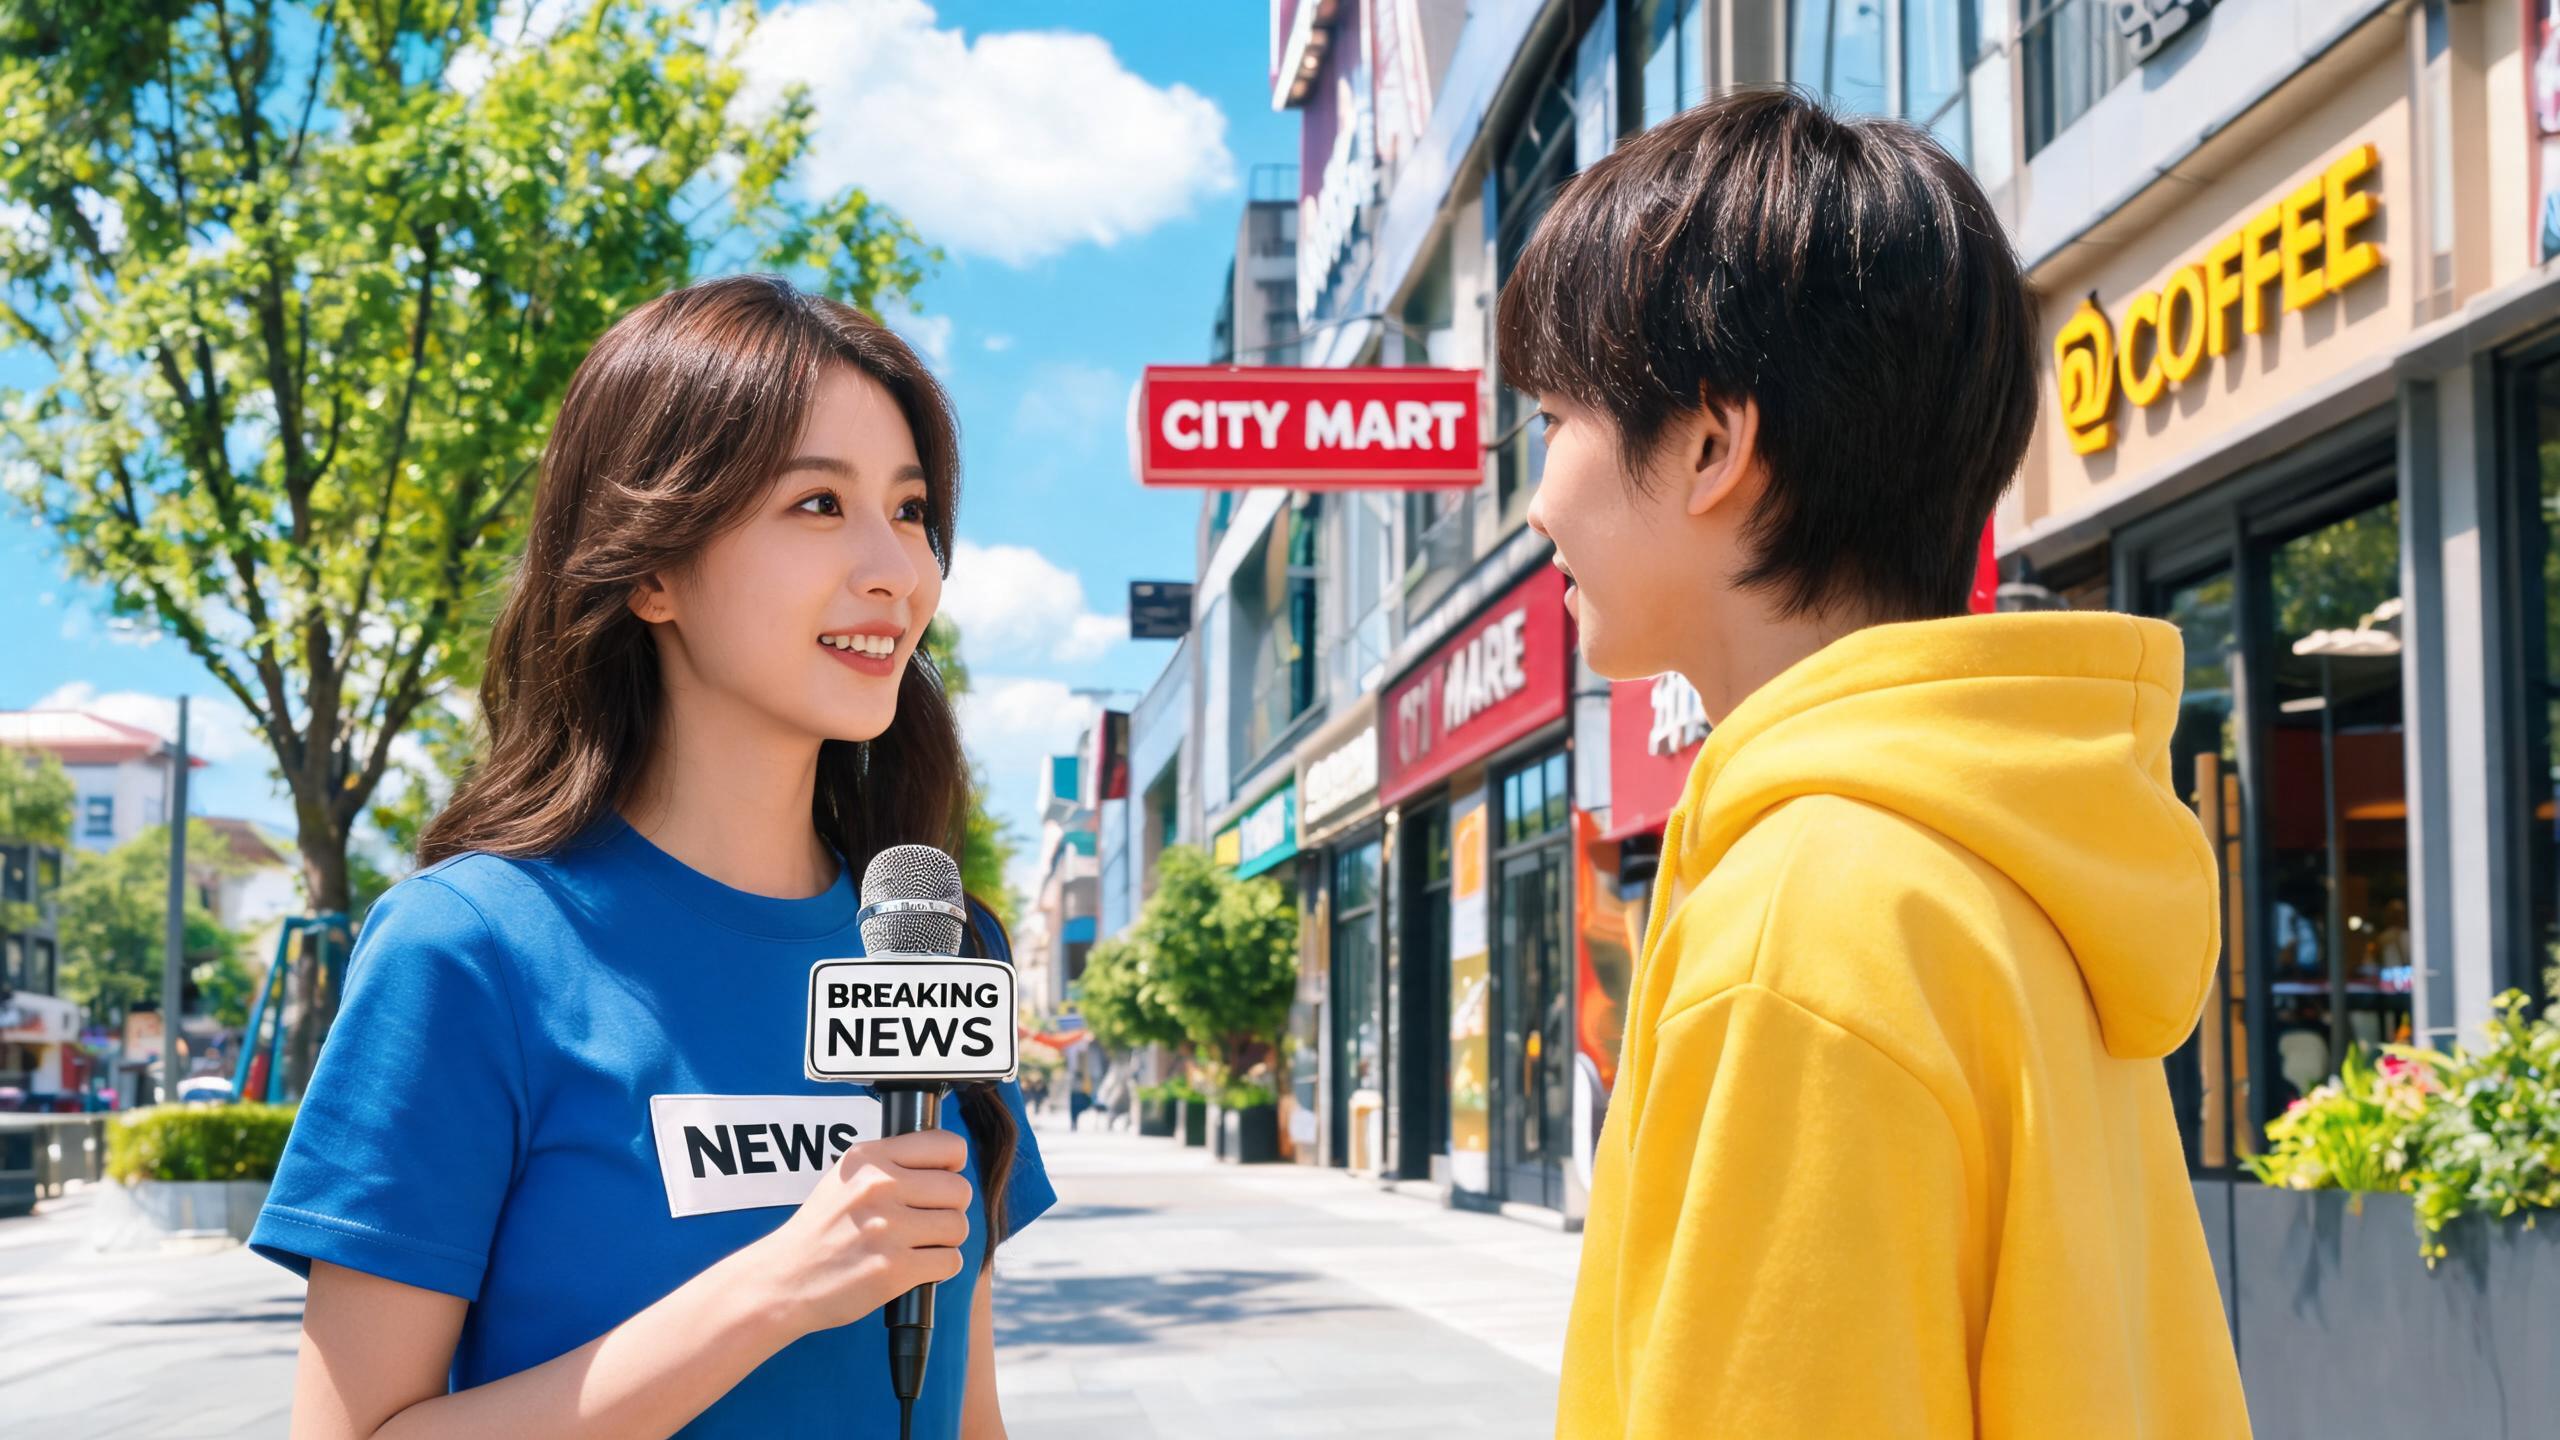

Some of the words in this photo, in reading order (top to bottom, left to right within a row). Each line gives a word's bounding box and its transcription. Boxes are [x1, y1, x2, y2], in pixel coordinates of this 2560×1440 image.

[1162, 399, 1289, 451] CITY
[1305, 399, 1466, 451] MART
[827, 982, 999, 1009] BREAKING
[827, 1016, 994, 1057] NEWS
[683, 1123, 858, 1178] NEWS
